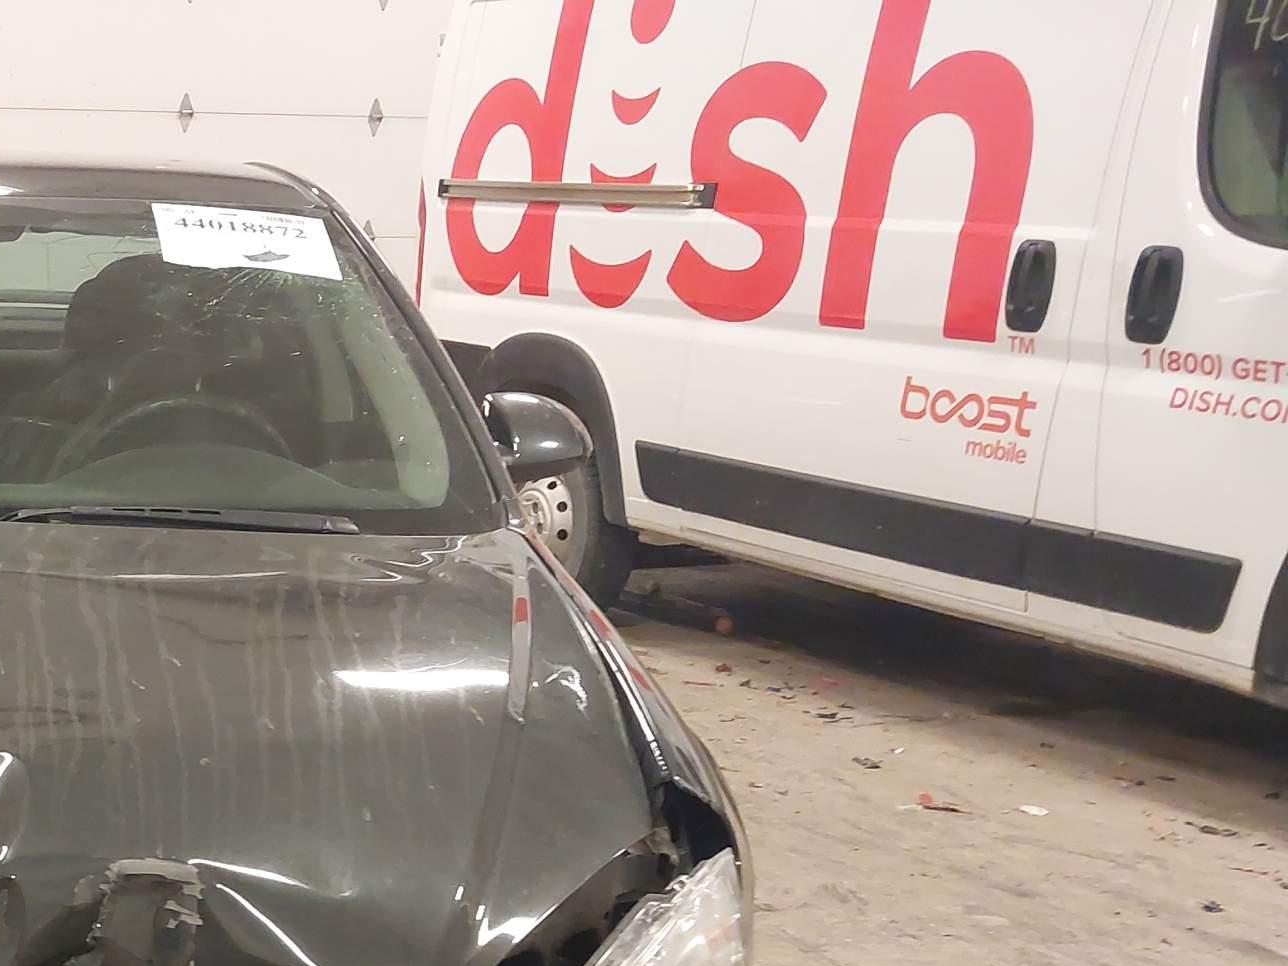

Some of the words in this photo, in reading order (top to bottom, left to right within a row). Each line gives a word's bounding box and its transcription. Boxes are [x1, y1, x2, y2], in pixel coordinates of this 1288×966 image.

[446, 0, 1034, 343] dish
[174, 217, 308, 239] 44018872
[1008, 336, 1036, 354] TM
[1141, 348, 1152, 369] 1
[1159, 348, 1223, 380] (800)
[900, 376, 1037, 438] boost
[964, 439, 1028, 465] mobile
